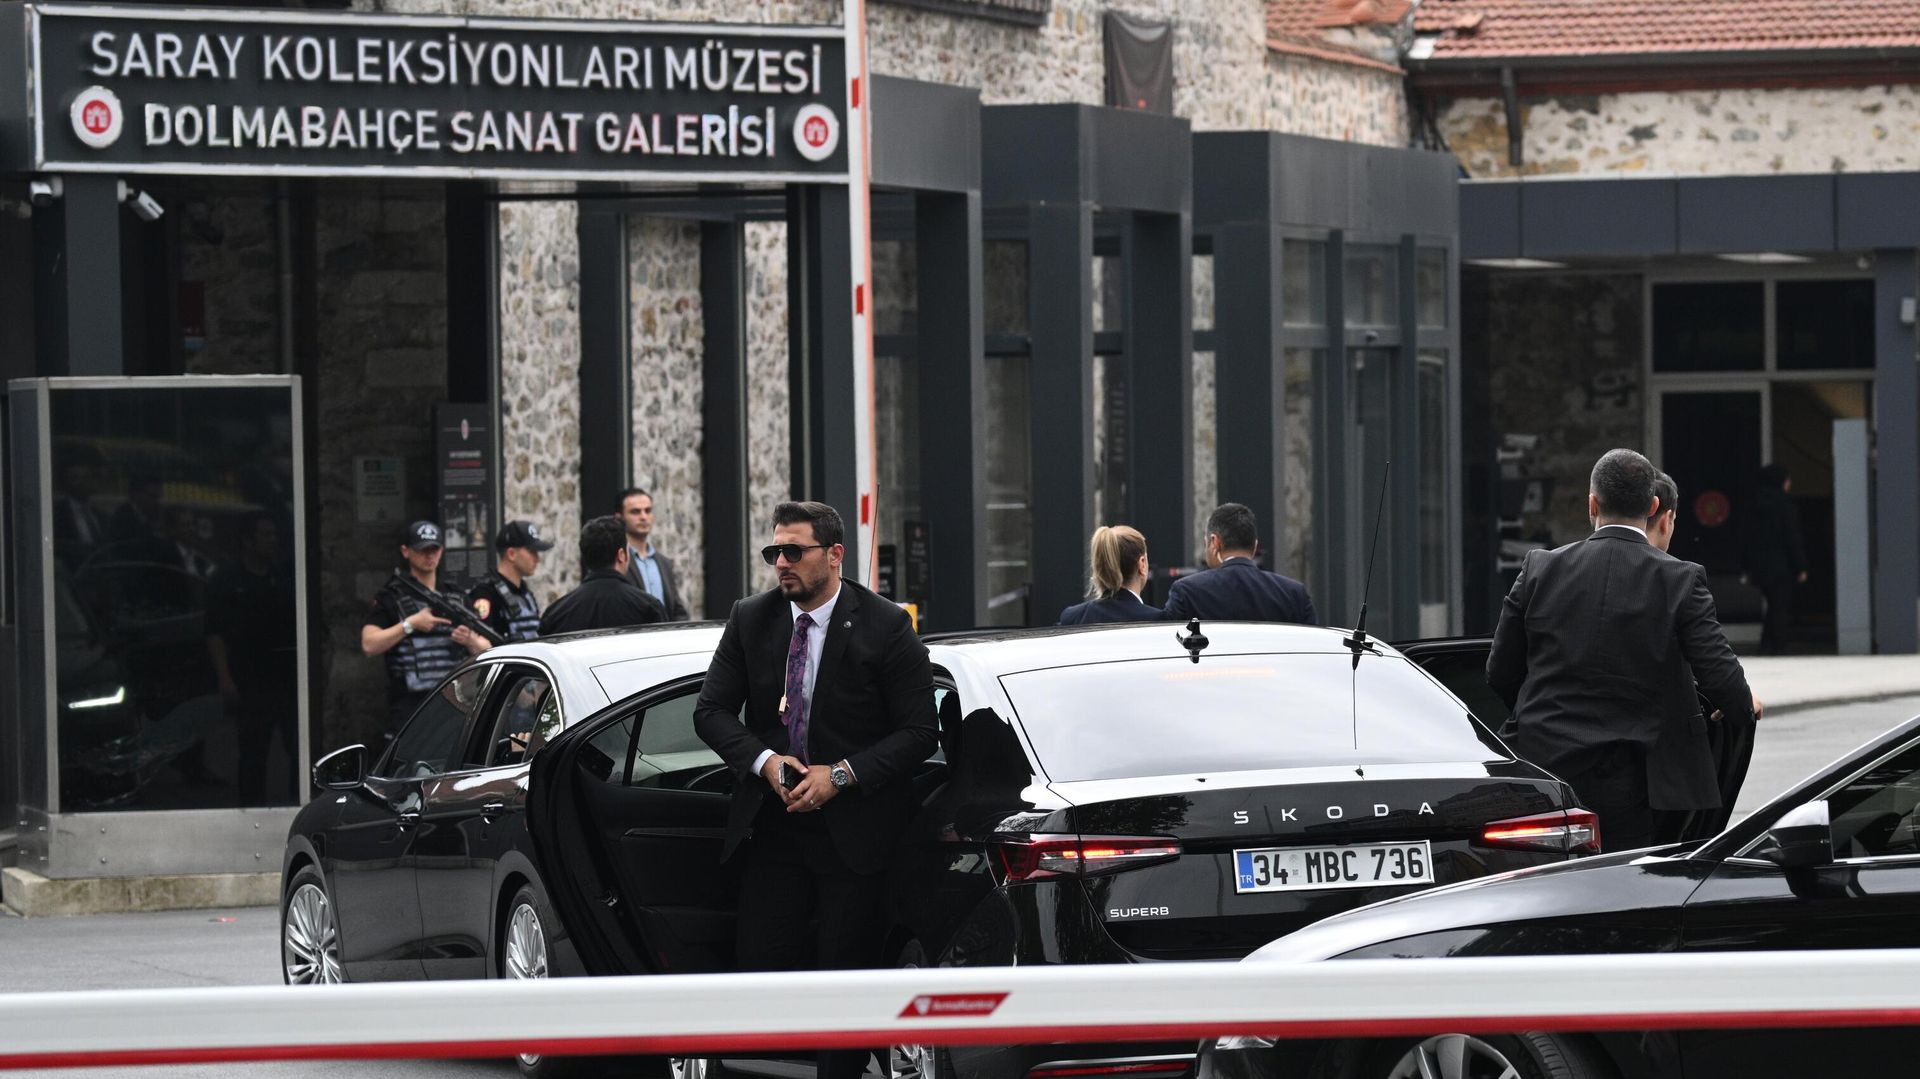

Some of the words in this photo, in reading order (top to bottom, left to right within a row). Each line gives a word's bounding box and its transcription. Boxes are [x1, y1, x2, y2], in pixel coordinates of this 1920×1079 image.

[92, 31, 245, 79] SARAY
[263, 33, 652, 89] KOLEKSİYONLARI
[665, 39, 821, 94] MÜZESİ
[144, 103, 440, 153] DOLMABAHÇE
[450, 110, 583, 153] SANAT
[596, 104, 776, 157] GALERİSİ
[1233, 802, 1434, 825] SKODA
[1240, 874, 1253, 884] TR
[1253, 854, 1288, 886] 34
[1305, 851, 1358, 883] MBC
[1370, 847, 1424, 880] 736
[1109, 906, 1169, 918] SUPERB
